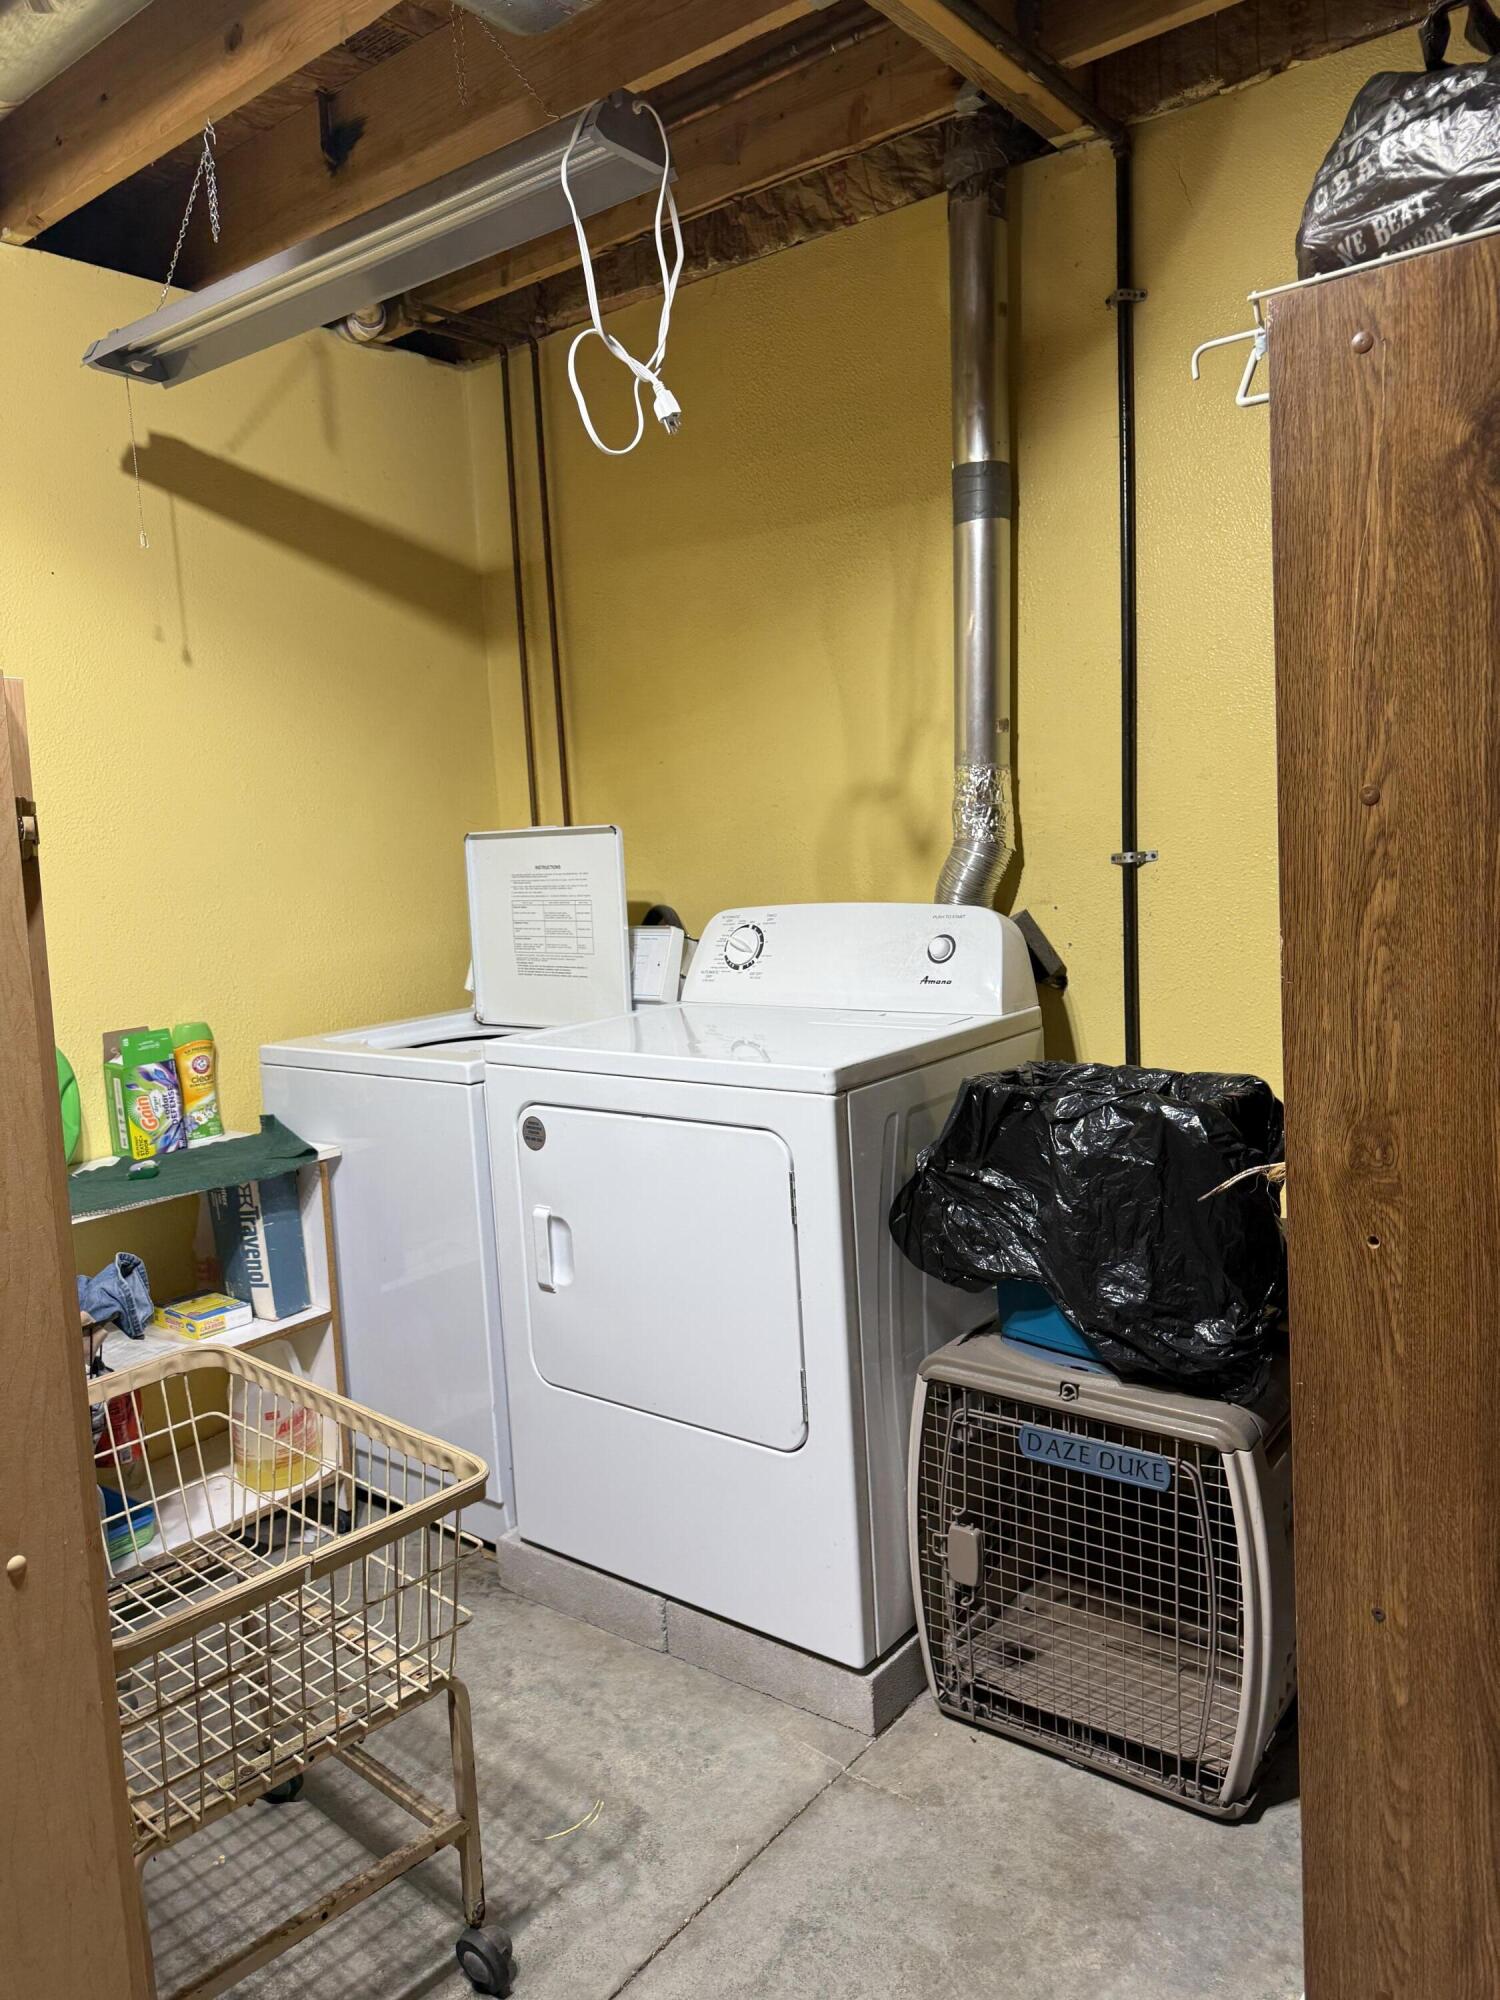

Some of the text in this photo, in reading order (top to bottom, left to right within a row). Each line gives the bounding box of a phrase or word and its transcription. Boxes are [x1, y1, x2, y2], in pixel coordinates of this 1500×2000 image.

[920, 976, 952, 984] Amana
[137, 1095, 159, 1131] Gain
[168, 1084, 178, 1126] DEFENSE
[240, 1206, 270, 1288] Travenol
[1027, 1431, 1165, 1484] DAZE DUKE
